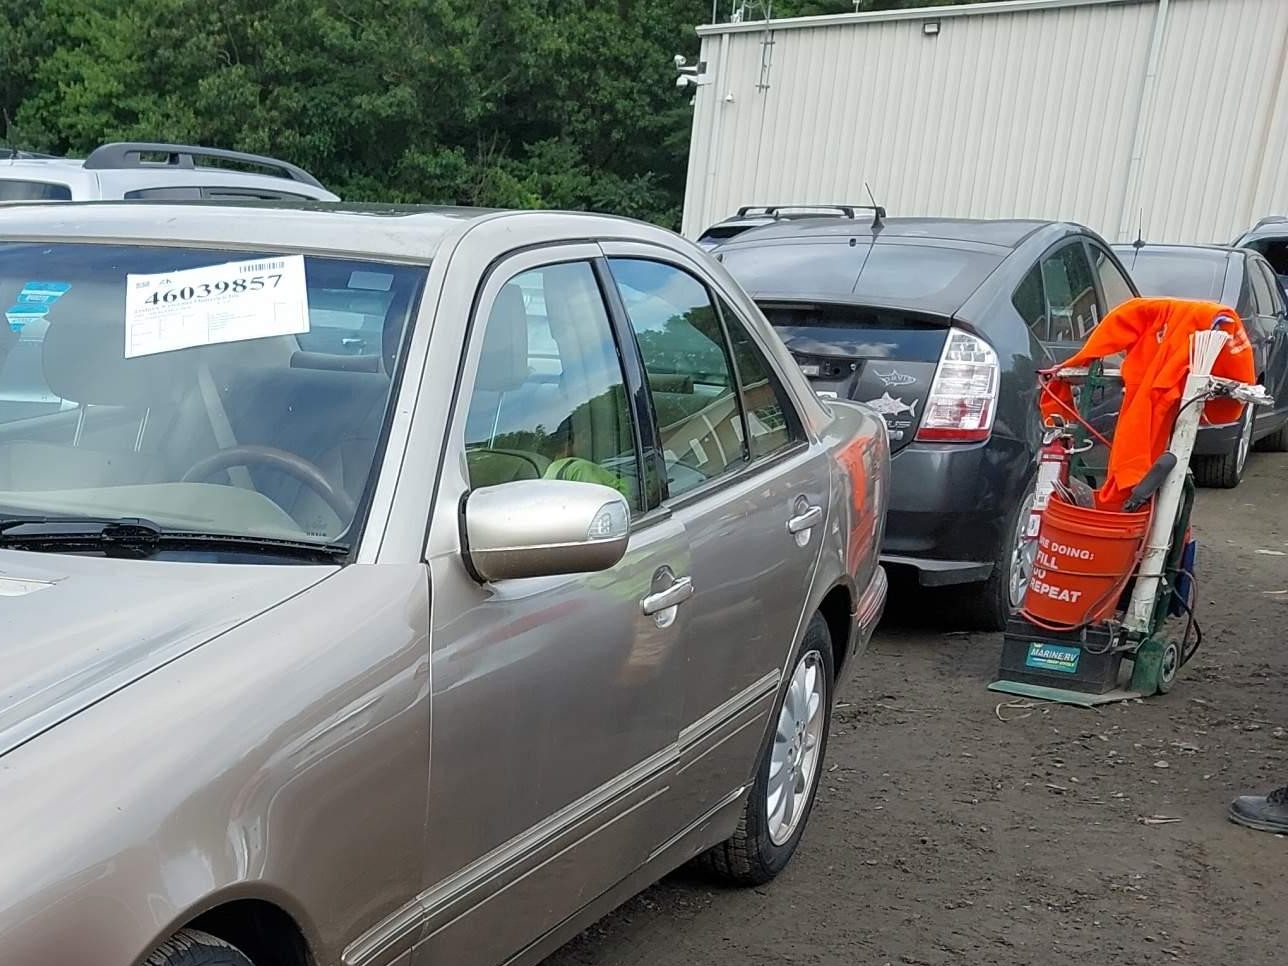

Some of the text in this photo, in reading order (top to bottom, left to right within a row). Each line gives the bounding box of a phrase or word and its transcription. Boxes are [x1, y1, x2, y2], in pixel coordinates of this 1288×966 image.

[144, 274, 283, 305] 46039857
[1036, 550, 1059, 570] FILL
[1030, 577, 1082, 603] REPEAT
